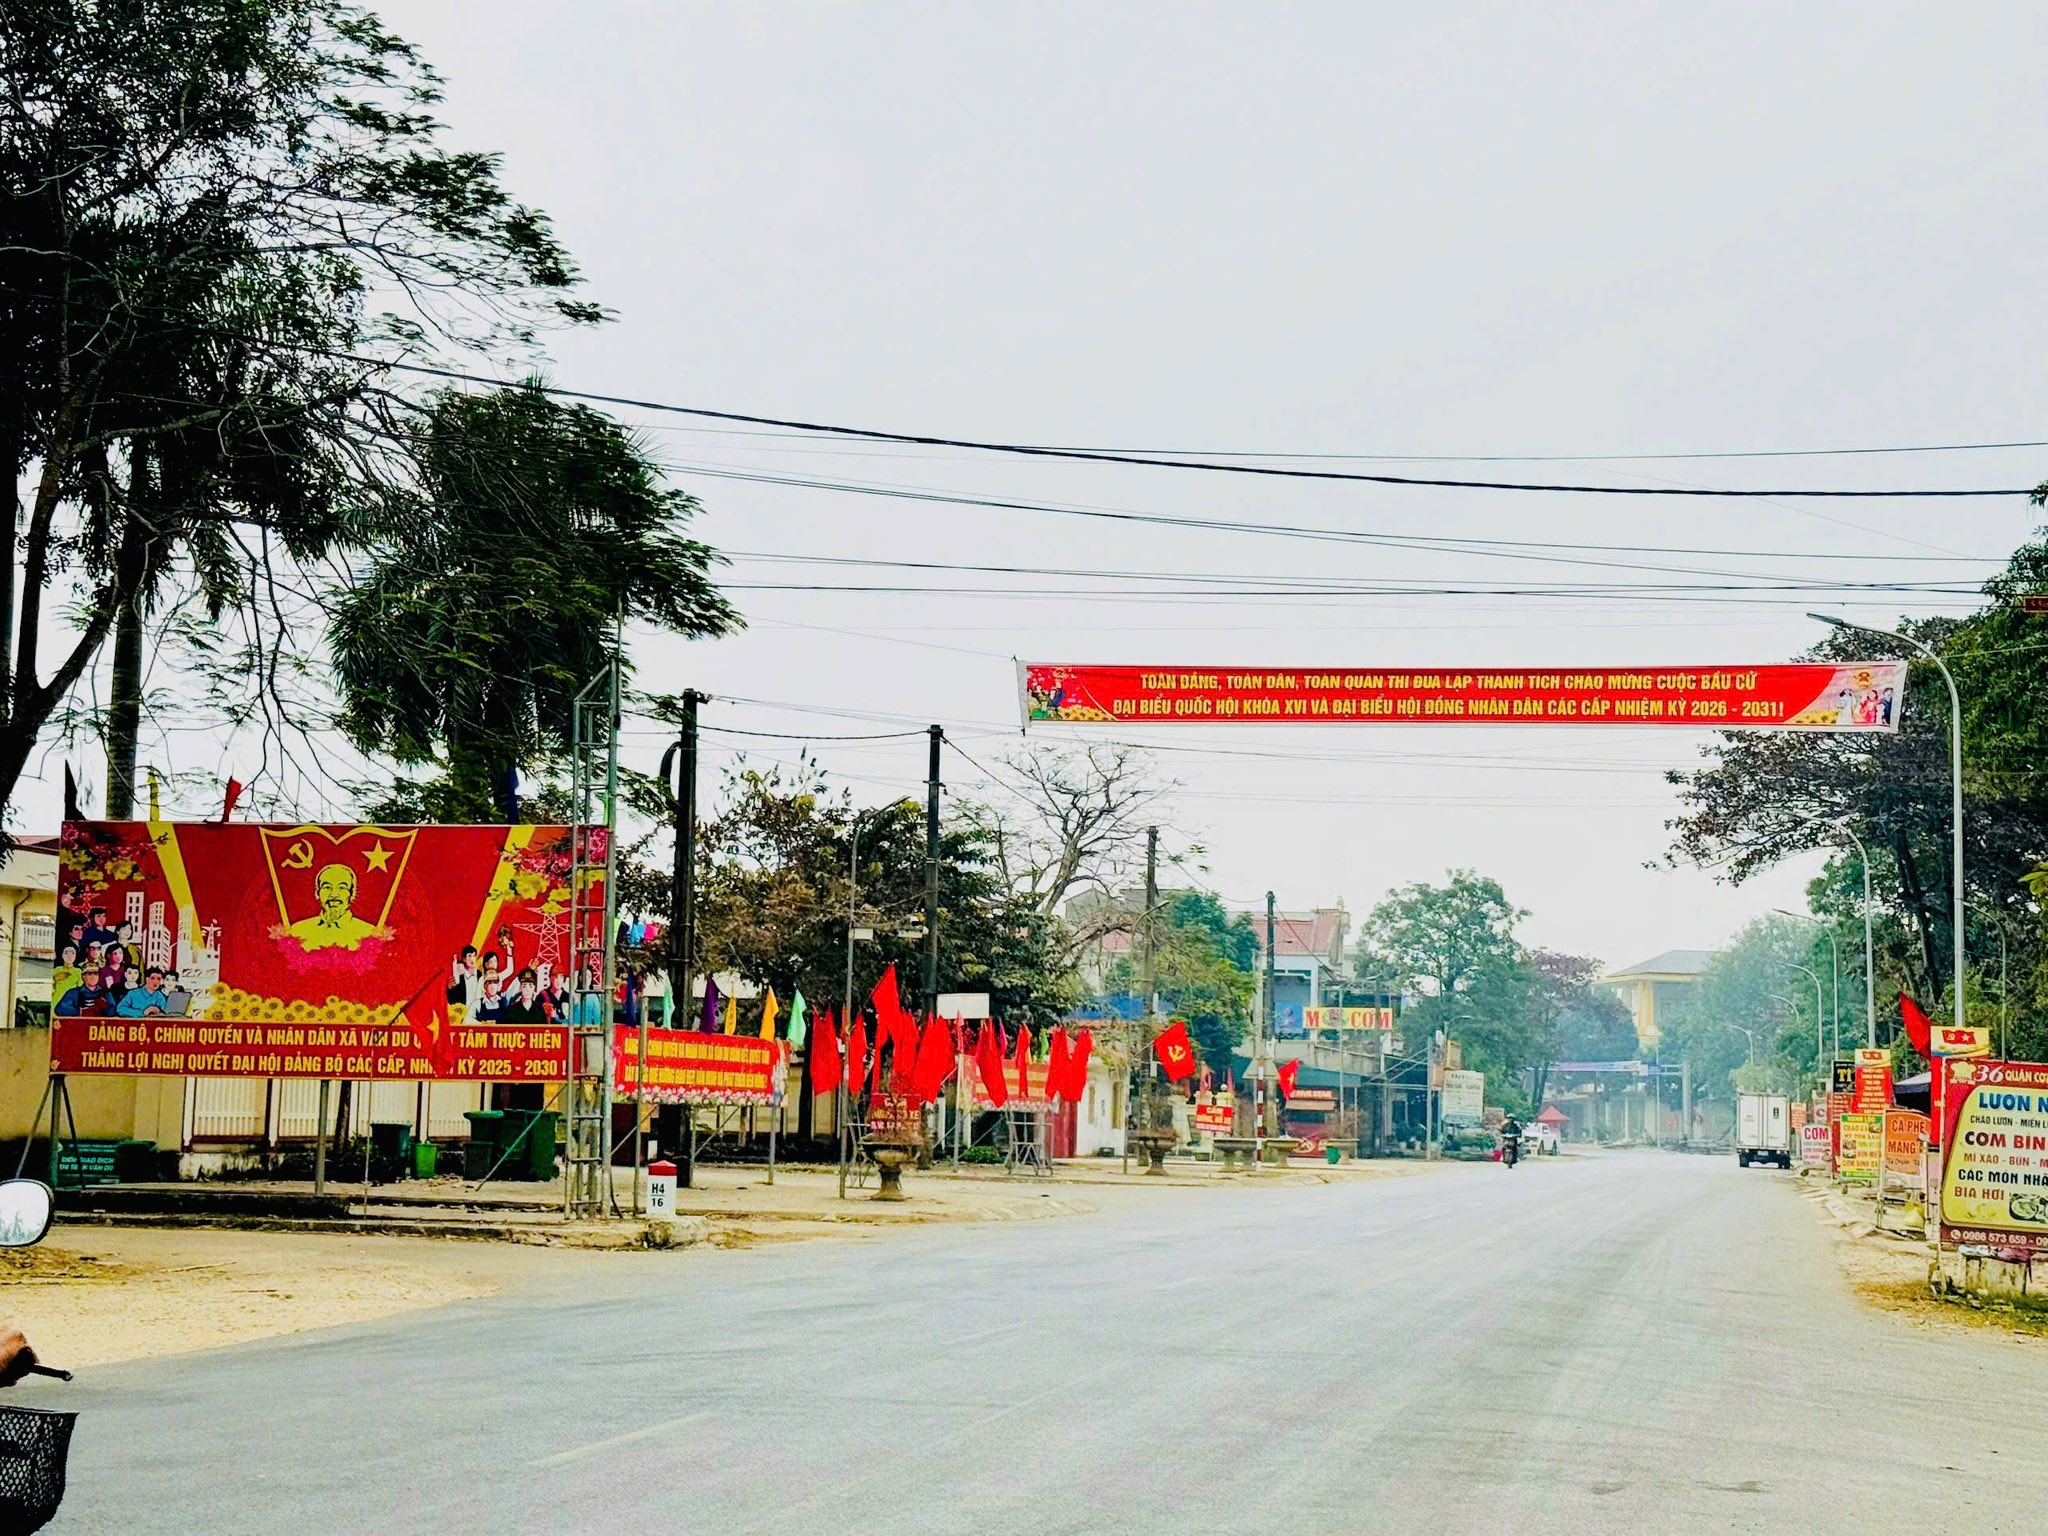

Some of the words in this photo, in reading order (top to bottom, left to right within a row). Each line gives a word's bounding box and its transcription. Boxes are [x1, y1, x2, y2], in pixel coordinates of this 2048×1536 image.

[1140, 673, 1176, 689] TOÀN
[1180, 671, 1221, 691] ĐẢNG,
[1226, 673, 1262, 689] TOÀN
[1266, 673, 1299, 690] DÂN,
[1304, 673, 1340, 689] TOÀN
[1344, 673, 1383, 690] QUÂN
[1388, 675, 1409, 689] THI
[1413, 675, 1441, 689] ĐUA
[1445, 673, 1473, 692] LẬP
[1477, 672, 1524, 689] THÀNH
[1528, 672, 1560, 689] TÍCH
[1564, 672, 1603, 689] CHÀO
[1608, 672, 1652, 689] MỪNG
[1656, 673, 1696, 693] CUỘC
[1701, 671, 1731, 690] BẦU
[1735, 670, 1758, 690] CỬ
[1113, 699, 1136, 717] ĐẠI
[1140, 693, 1171, 714] BIỂU
[1175, 695, 1212, 715] QUỐC
[1215, 697, 1239, 717] HỘI
[1243, 696, 1280, 714] KHÓA
[1284, 699, 1307, 714] XVI
[1310, 696, 1328, 714] VÀ
[1333, 699, 1356, 717] ĐẠI
[1360, 693, 1393, 714] BIỂU
[1397, 697, 1420, 717] HỘI
[1424, 694, 1464, 715] ĐỒNG
[1468, 697, 1509, 715] NHÂN
[1513, 697, 1543, 715] DÂN
[1547, 697, 1577, 715] CÁC
[1581, 695, 1611, 715] CẤP
[1615, 697, 1664, 719] NHIỆM
[1668, 697, 1687, 716] KỲ
[1691, 701, 1727, 716] 2026
[1742, 701, 1784, 717] 2031!
[89, 1021, 125, 1041] ĐẢNG
[129, 1023, 150, 1045] BỘ,
[154, 1024, 194, 1043] CHÍNH
[199, 1024, 242, 1045] QUYỀN
[246, 1026, 263, 1044] VÀ
[266, 1026, 304, 1045] NHÂN
[308, 1027, 336, 1046] DÂN
[339, 1028, 357, 1046] XÃ
[391, 1031, 410, 1047] DU
[459, 1029, 487, 1048] TÂM
[491, 1031, 526, 1052] THỰC
[529, 1030, 561, 1052] HIỆN
[128, 1051, 149, 1071] LỢI
[152, 1053, 184, 1073] NGHỊ
[187, 1050, 229, 1071] QUYẾT
[232, 1054, 255, 1074] ĐẠI
[258, 1052, 280, 1075] HỘI
[284, 1051, 321, 1072] ĐẢNG
[325, 1053, 343, 1076] BỘ
[347, 1053, 372, 1073] CÁC
[377, 1052, 406, 1076] CẤP,
[457, 1055, 475, 1074] KỲ
[478, 1060, 512, 1075] 2025
[524, 1060, 557, 1076] 2030
[1973, 1065, 2004, 1083] 36
[2005, 1069, 2032, 1082] QUÁN
[1805, 1127, 1828, 1140] CƠM
[1888, 1141, 1915, 1154] MANG
[652, 1183, 665, 1194] H4
[1954, 1187, 1976, 1198] BIA
[1982, 1189, 2004, 1200] HƠI
[652, 1198, 664, 1207] 16
